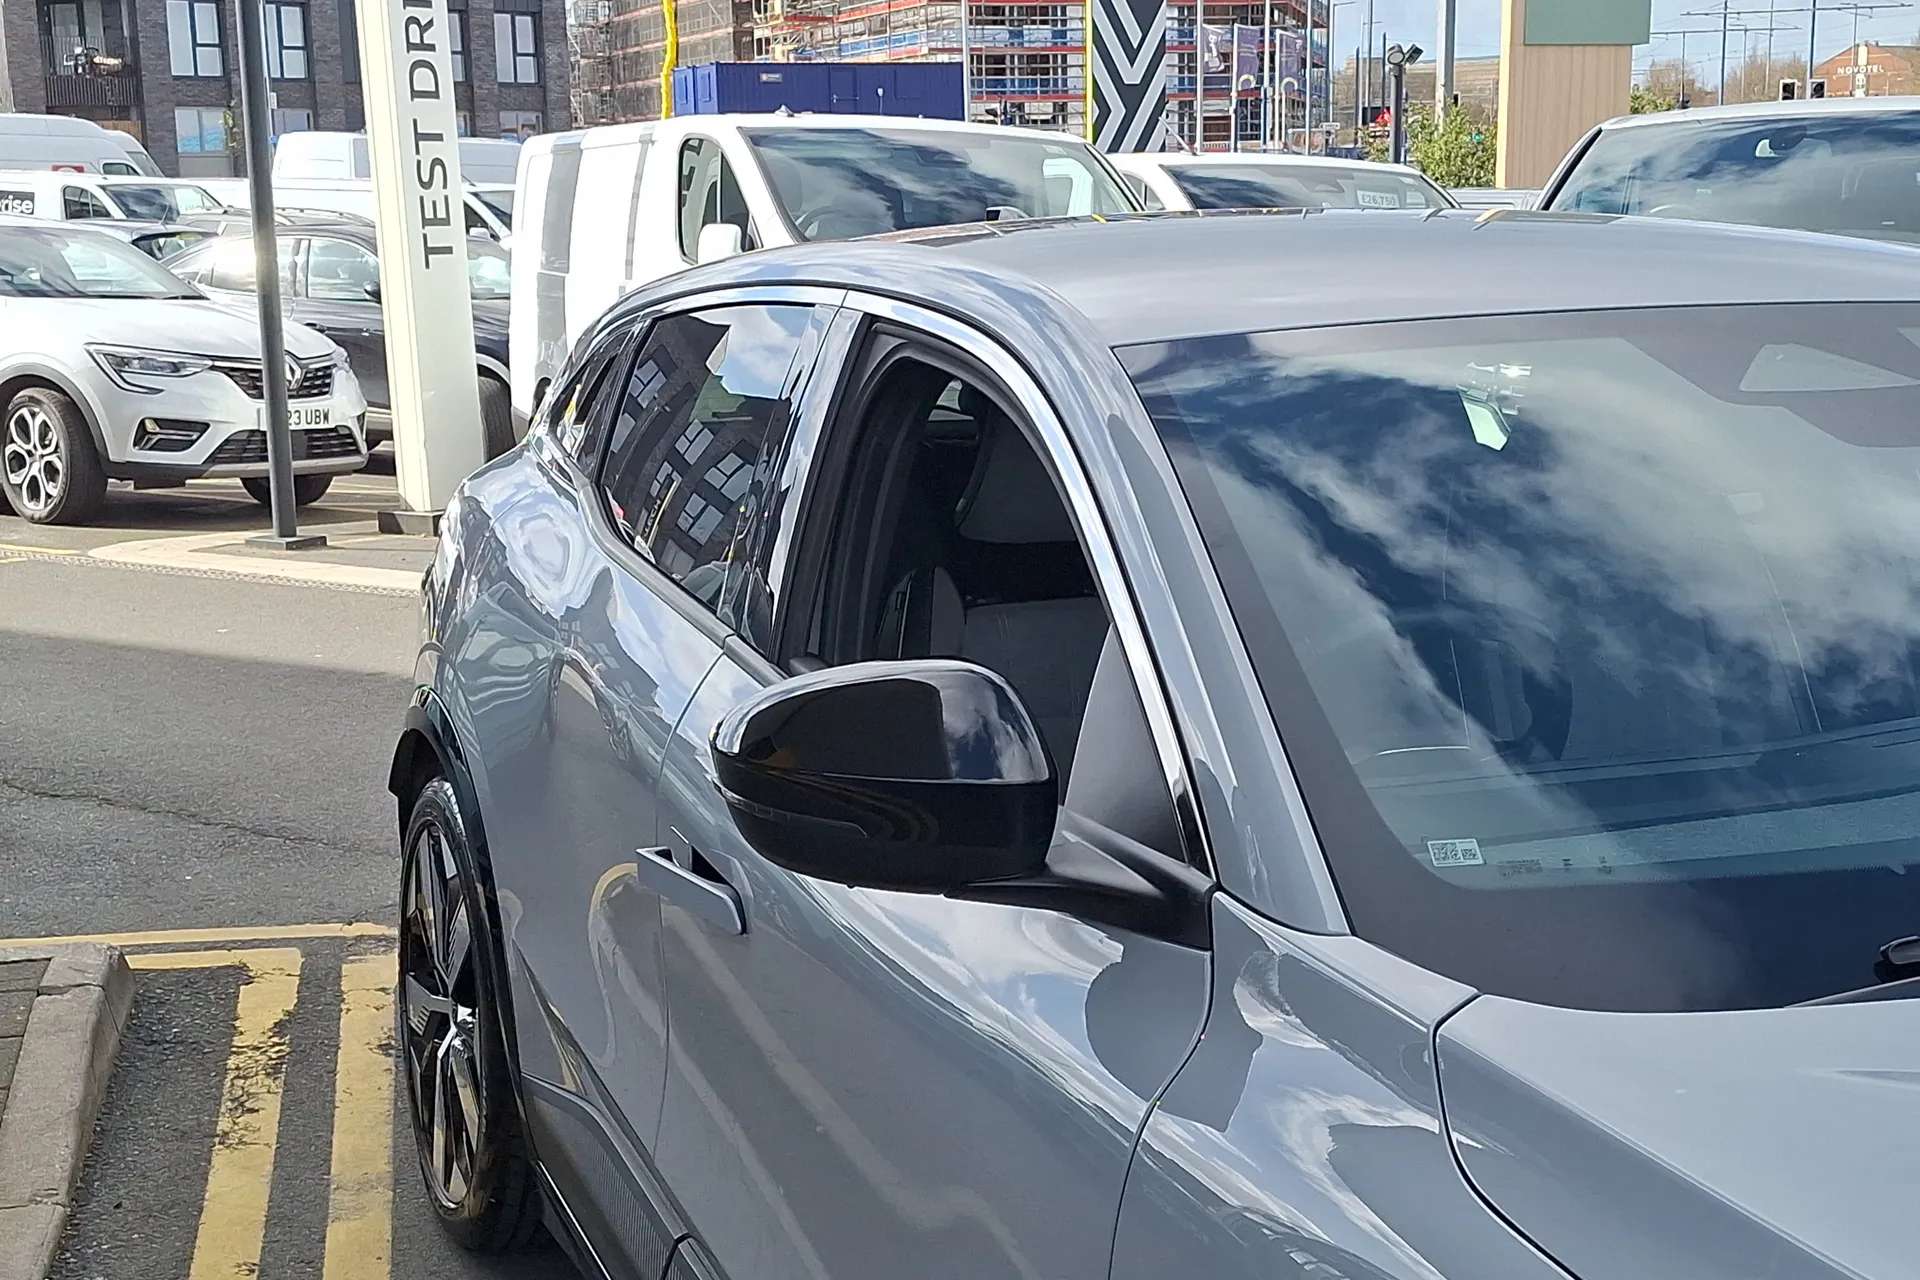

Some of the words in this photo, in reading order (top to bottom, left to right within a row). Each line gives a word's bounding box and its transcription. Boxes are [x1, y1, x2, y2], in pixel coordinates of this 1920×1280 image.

[401, 0, 441, 102] DRI
[1836, 64, 1885, 74] NOVOTEL
[0, 194, 34, 214] rise
[411, 118, 454, 270] TEST
[304, 408, 330, 425] UBW
